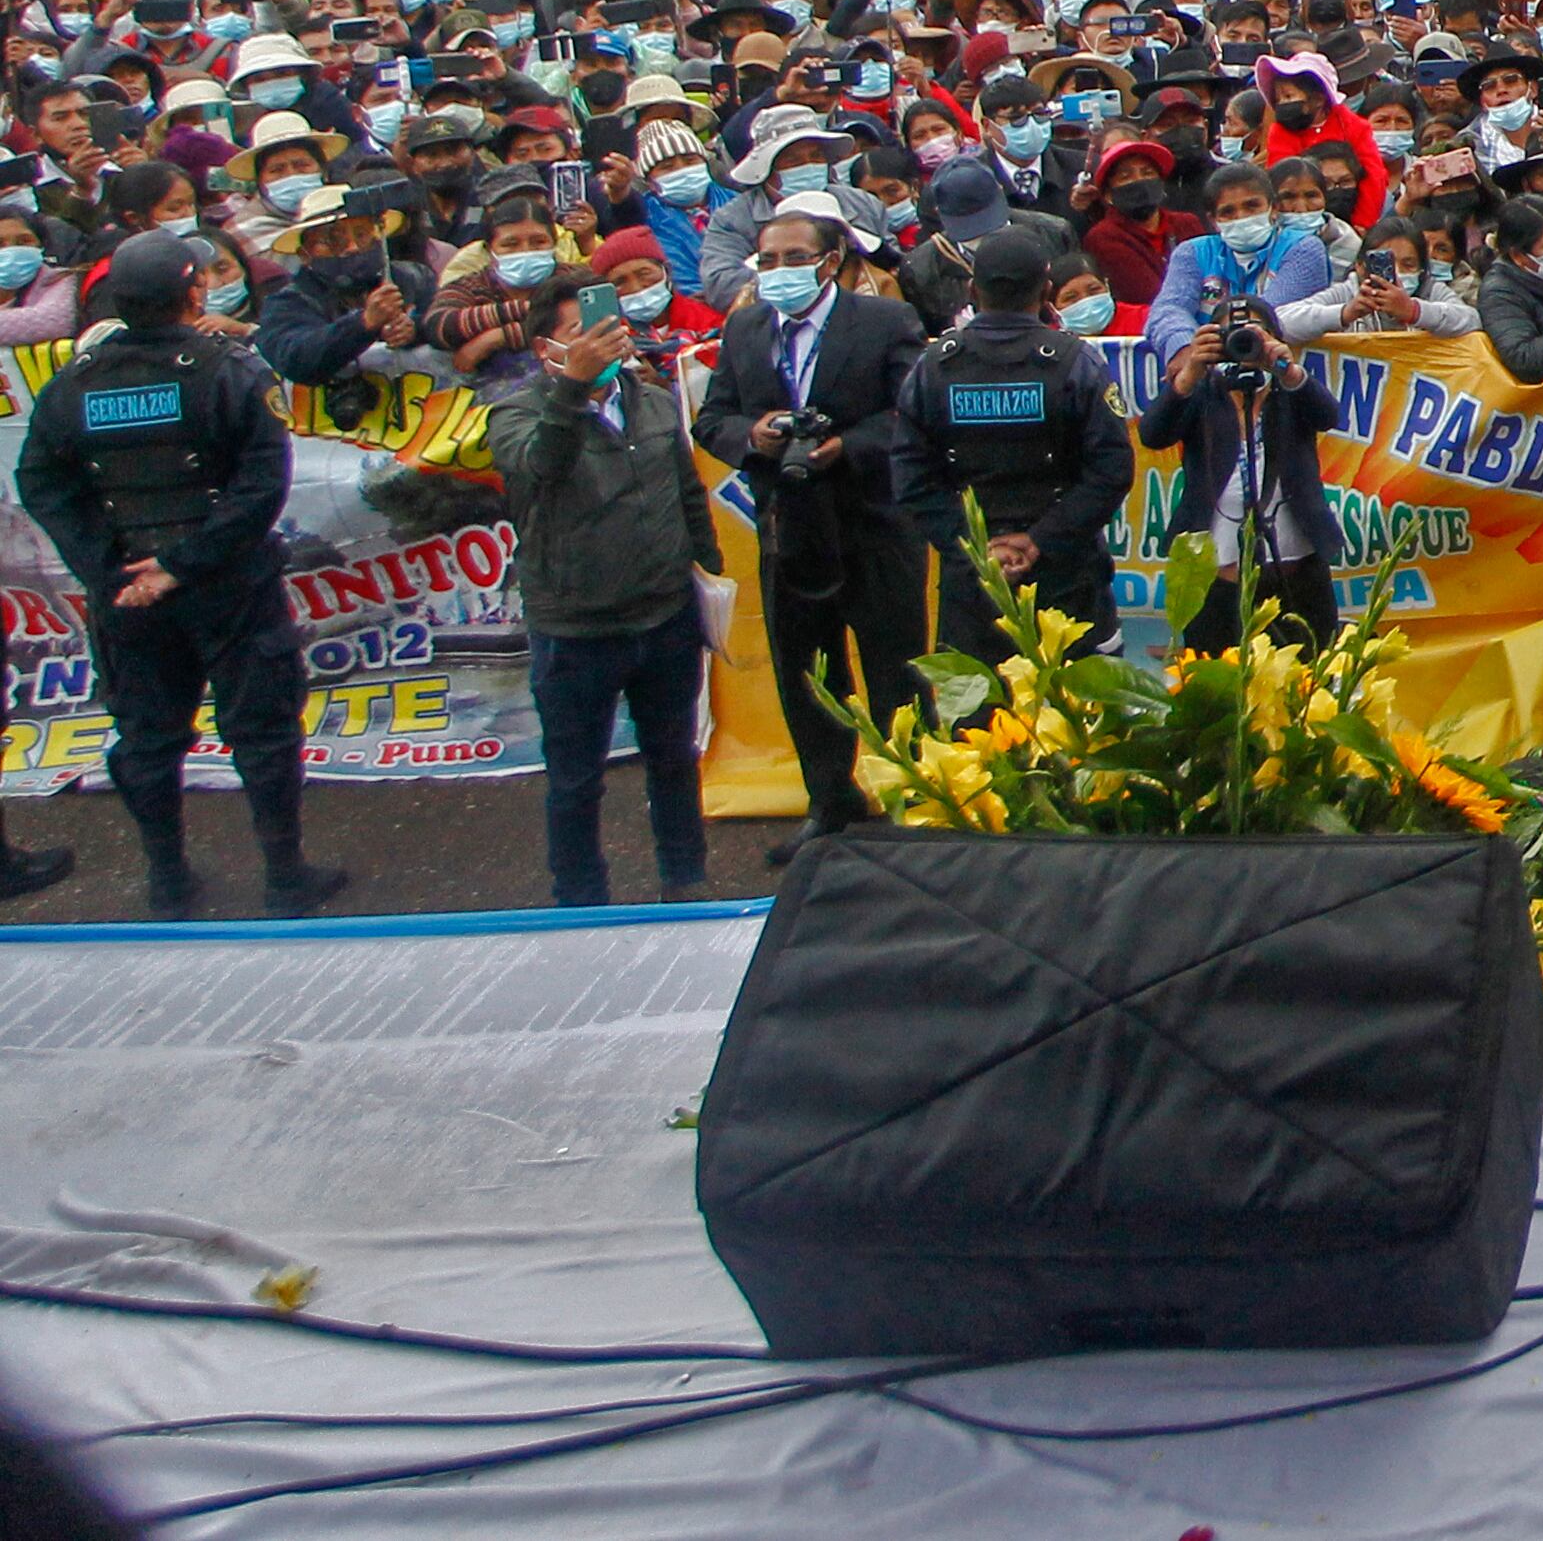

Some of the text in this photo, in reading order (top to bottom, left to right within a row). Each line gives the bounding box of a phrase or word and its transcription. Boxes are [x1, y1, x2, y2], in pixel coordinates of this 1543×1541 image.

[89, 390, 178, 423] SERENAZGO
[954, 389, 1040, 418] SERENAZGO
[377, 738, 503, 765] Puno
